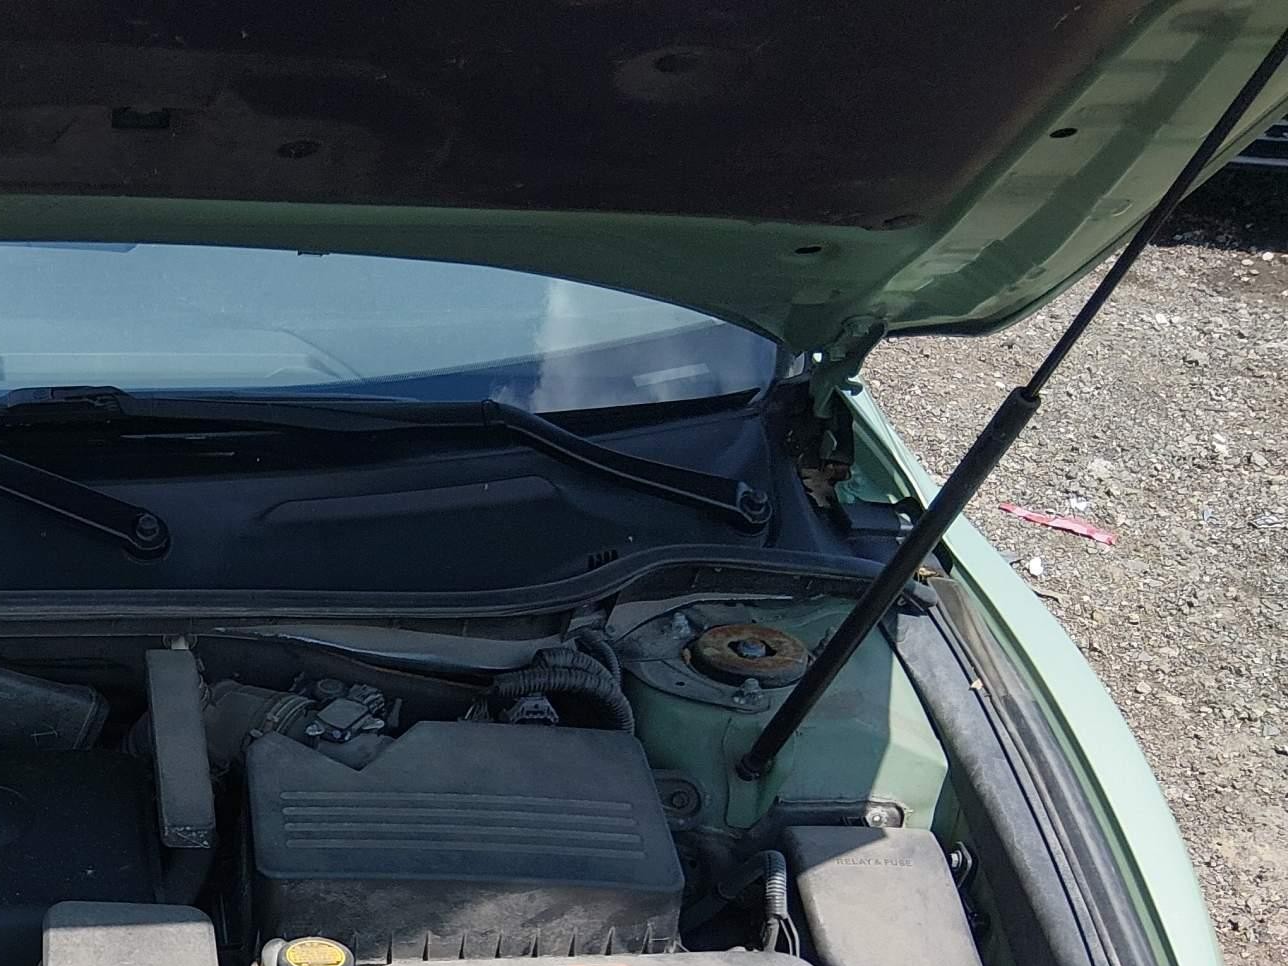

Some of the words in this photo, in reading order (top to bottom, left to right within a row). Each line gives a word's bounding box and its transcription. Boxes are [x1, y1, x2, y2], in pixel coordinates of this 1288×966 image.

[836, 858, 872, 866] RELAY
[874, 858, 882, 866] &
[884, 858, 913, 867] FUSE
